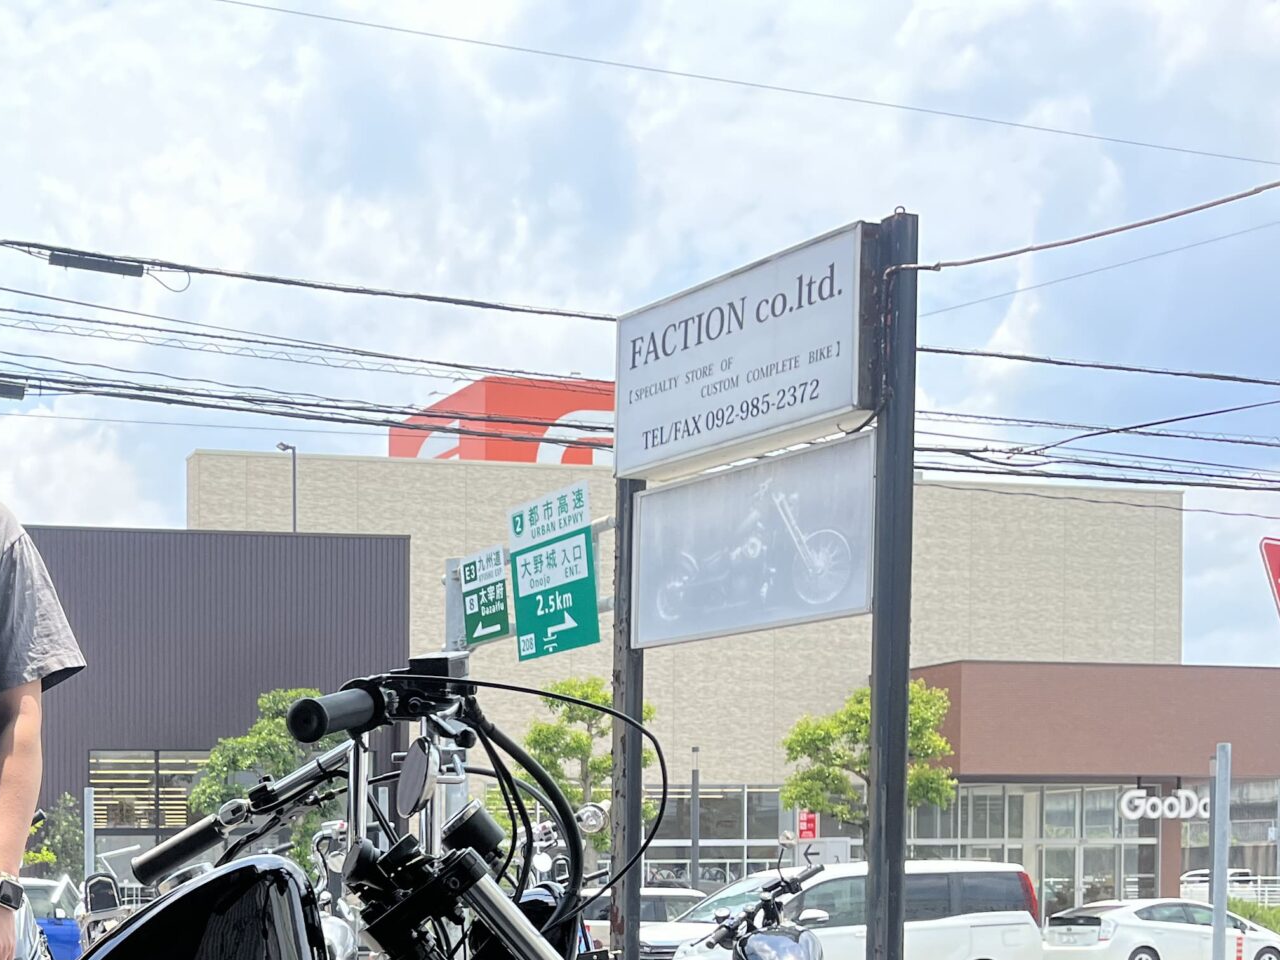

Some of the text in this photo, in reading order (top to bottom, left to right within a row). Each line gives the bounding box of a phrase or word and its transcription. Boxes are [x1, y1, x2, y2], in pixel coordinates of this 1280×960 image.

[629, 261, 843, 370] FACTION co.ltd.
[685, 362, 714, 384] STORE
[720, 356, 734, 372] OF
[700, 374, 740, 398] CUSTOM
[746, 355, 800, 384] COMPLETE
[642, 414, 702, 450] TEL/FAX
[705, 378, 820, 431] 092-985-2372
[528, 488, 585, 527] 都市高速
[531, 511, 584, 539] URBAN EXPWY
[465, 565, 476, 581] E3
[536, 590, 573, 616] 2.5km
[522, 637, 534, 652] 208
